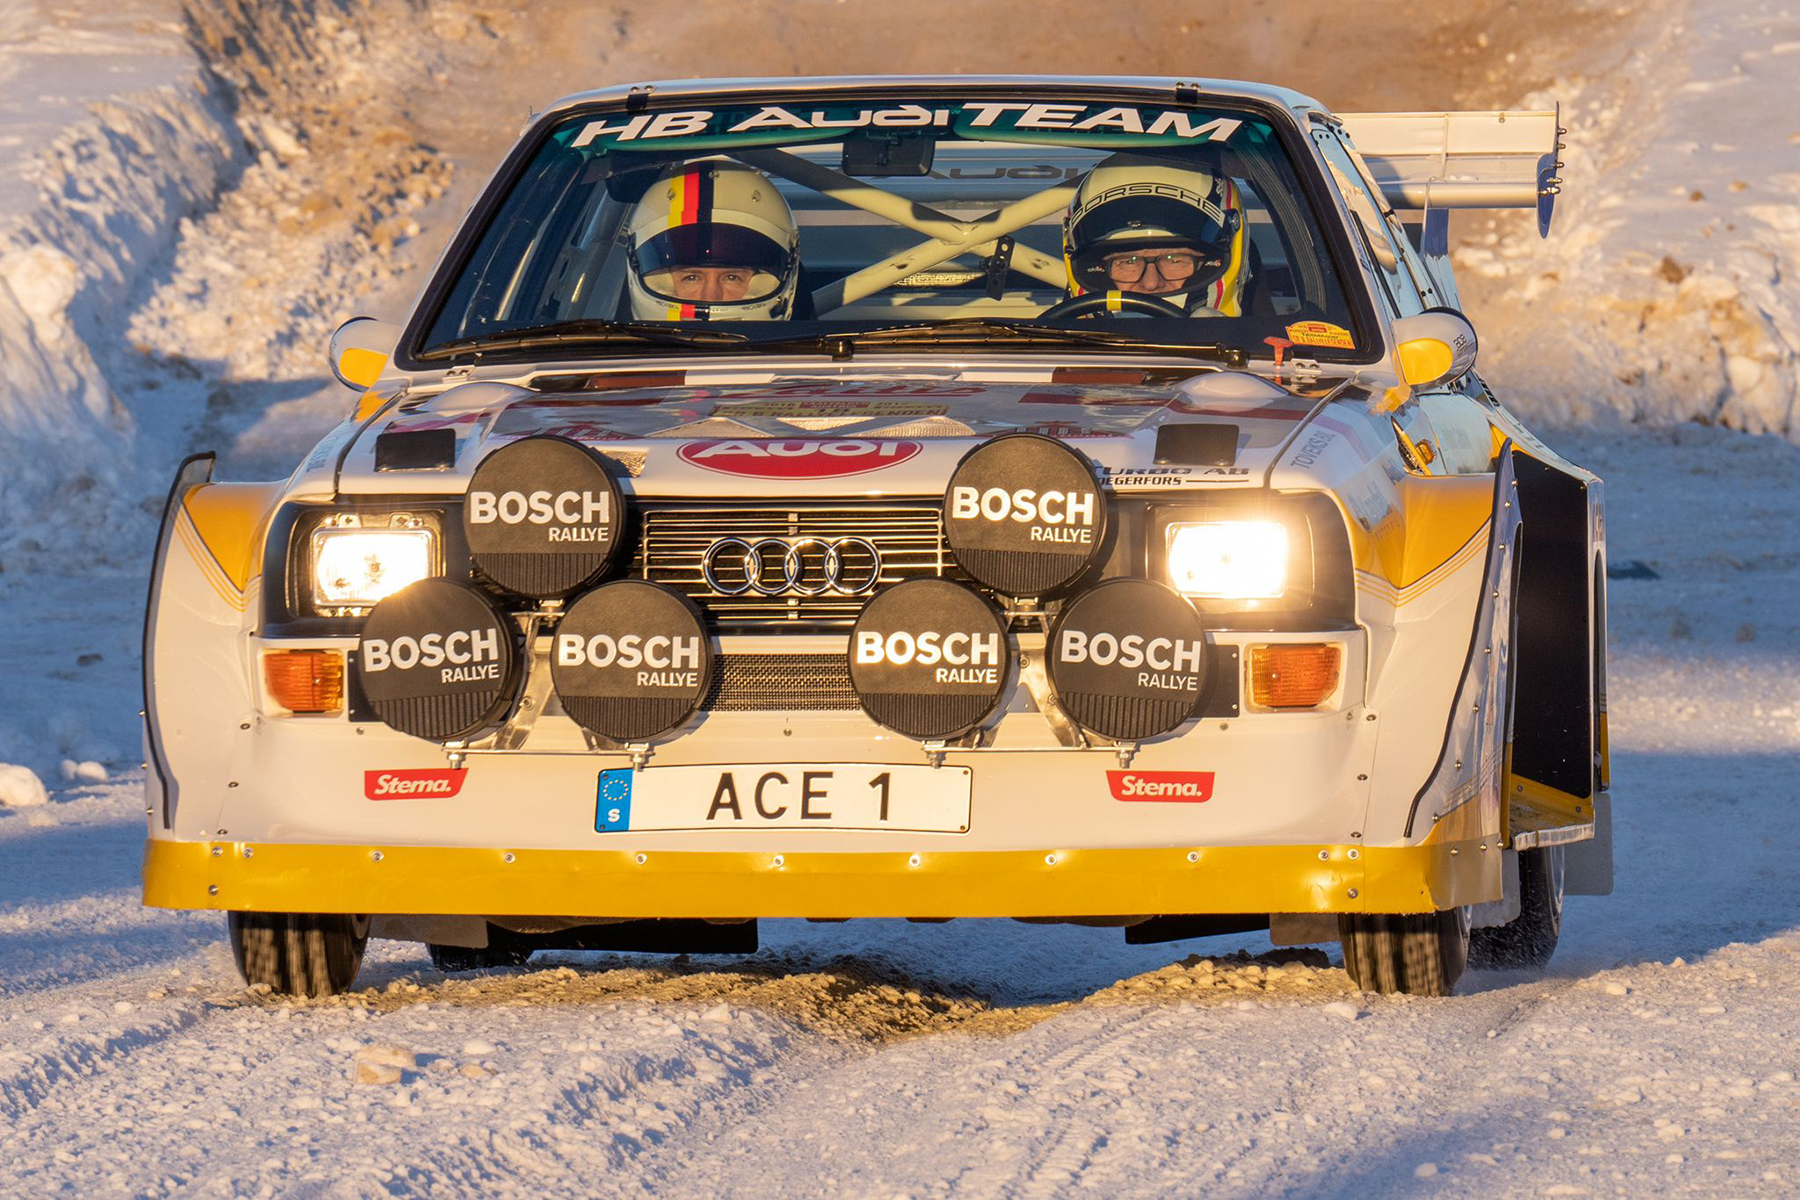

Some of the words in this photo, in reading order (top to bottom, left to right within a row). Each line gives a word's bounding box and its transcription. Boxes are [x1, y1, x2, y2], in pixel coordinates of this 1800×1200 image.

[570, 111, 714, 147] HB
[962, 103, 1243, 141] TEAM
[1071, 184, 1224, 228] PORSCHE
[470, 491, 610, 524] BOSCH
[952, 486, 1094, 525] BOSCH
[549, 527, 609, 542] RALLYE
[1030, 526, 1092, 543] RALLYE
[363, 627, 498, 672] BOSCH
[558, 634, 699, 669] BOSCH
[857, 631, 997, 665] BOSCH
[1060, 630, 1201, 673] BOSCH
[441, 663, 500, 683] RALLYE
[636, 671, 698, 687] RALLYE
[935, 668, 998, 684] RALLYE
[1137, 671, 1198, 691] RALLYE
[706, 771, 834, 820] ACE
[868, 772, 890, 821] 1
[608, 808, 620, 822] S
